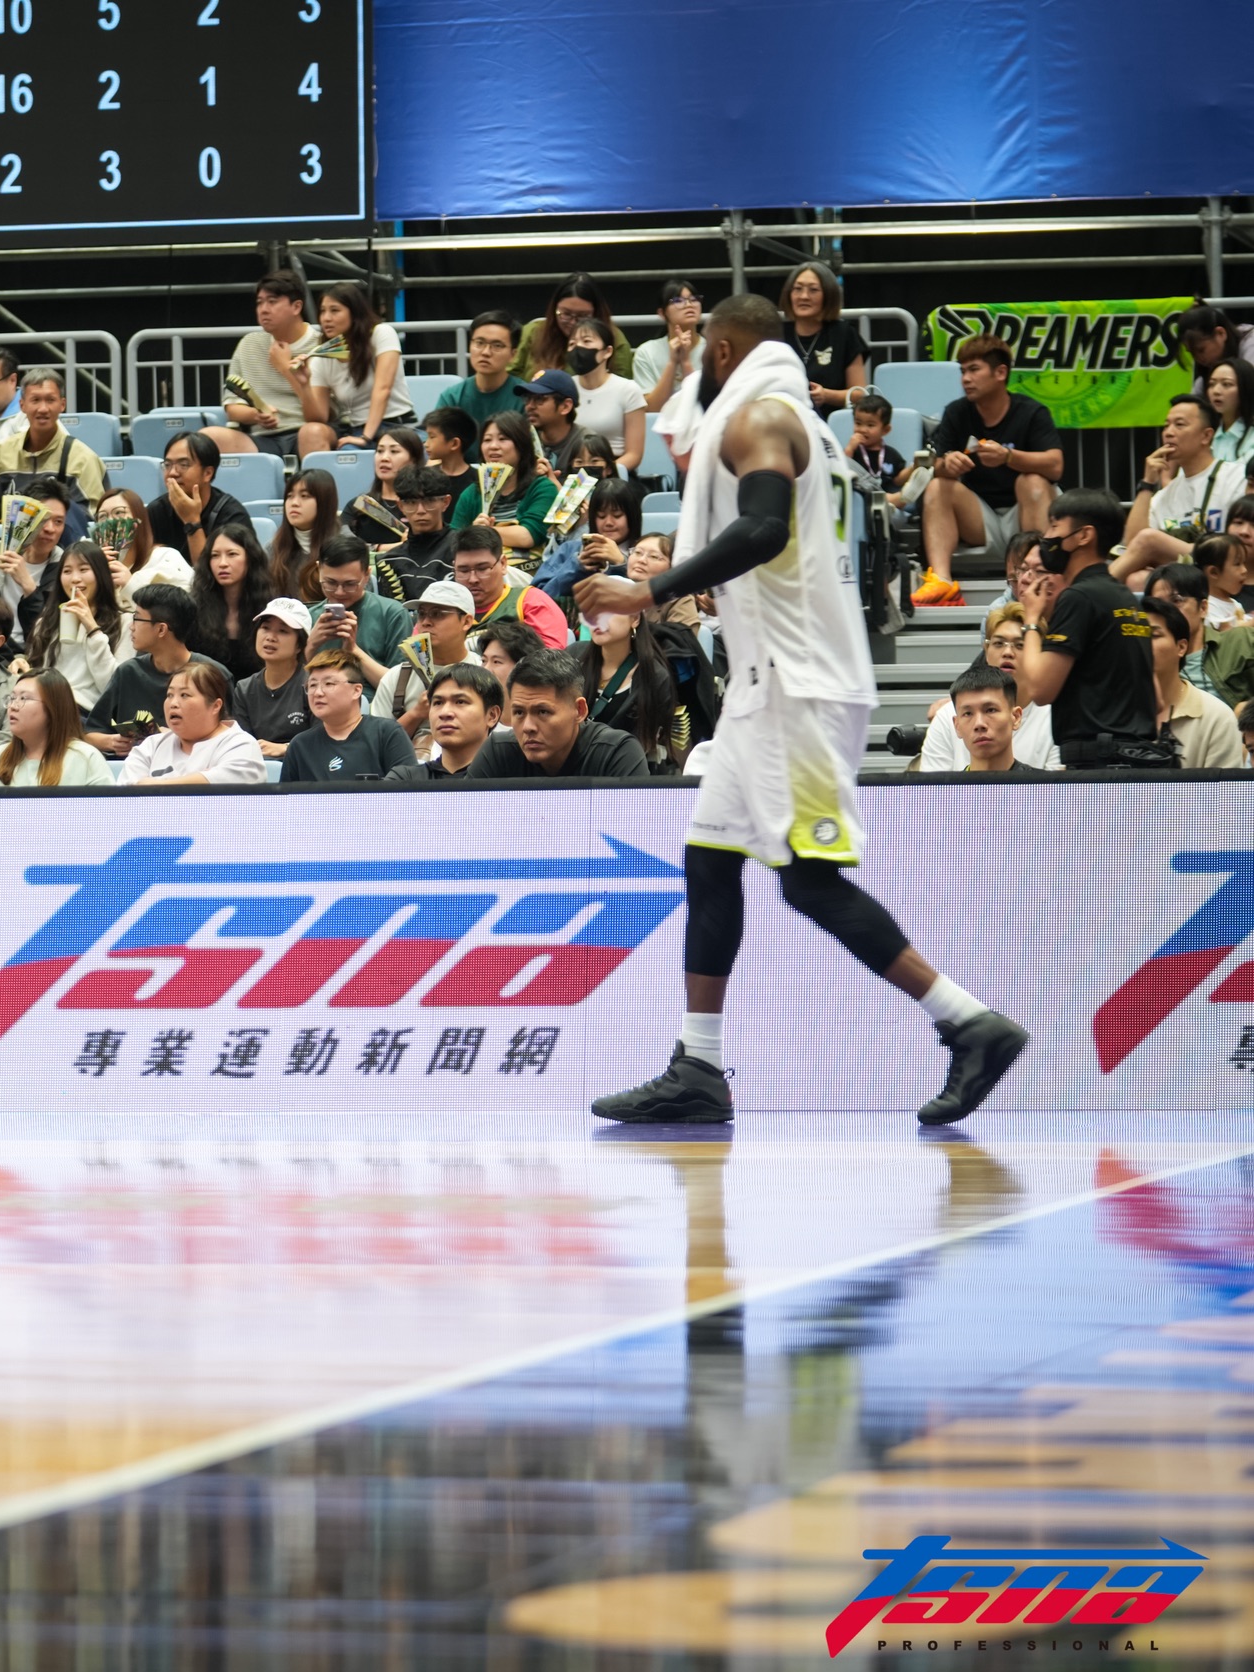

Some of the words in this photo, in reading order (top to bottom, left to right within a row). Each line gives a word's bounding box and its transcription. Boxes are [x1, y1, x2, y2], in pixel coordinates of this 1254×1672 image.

[98, 0, 121, 31] 5
[197, 0, 220, 26] 2
[98, 70, 121, 110] 2
[199, 66, 216, 106] 1
[298, 62, 323, 102] 4
[0, 153, 23, 194] 2
[99, 150, 122, 191] 3
[199, 146, 222, 188] 0
[299, 143, 323, 185] 3
[73, 1026, 561, 1077] 專業運動新聞網
